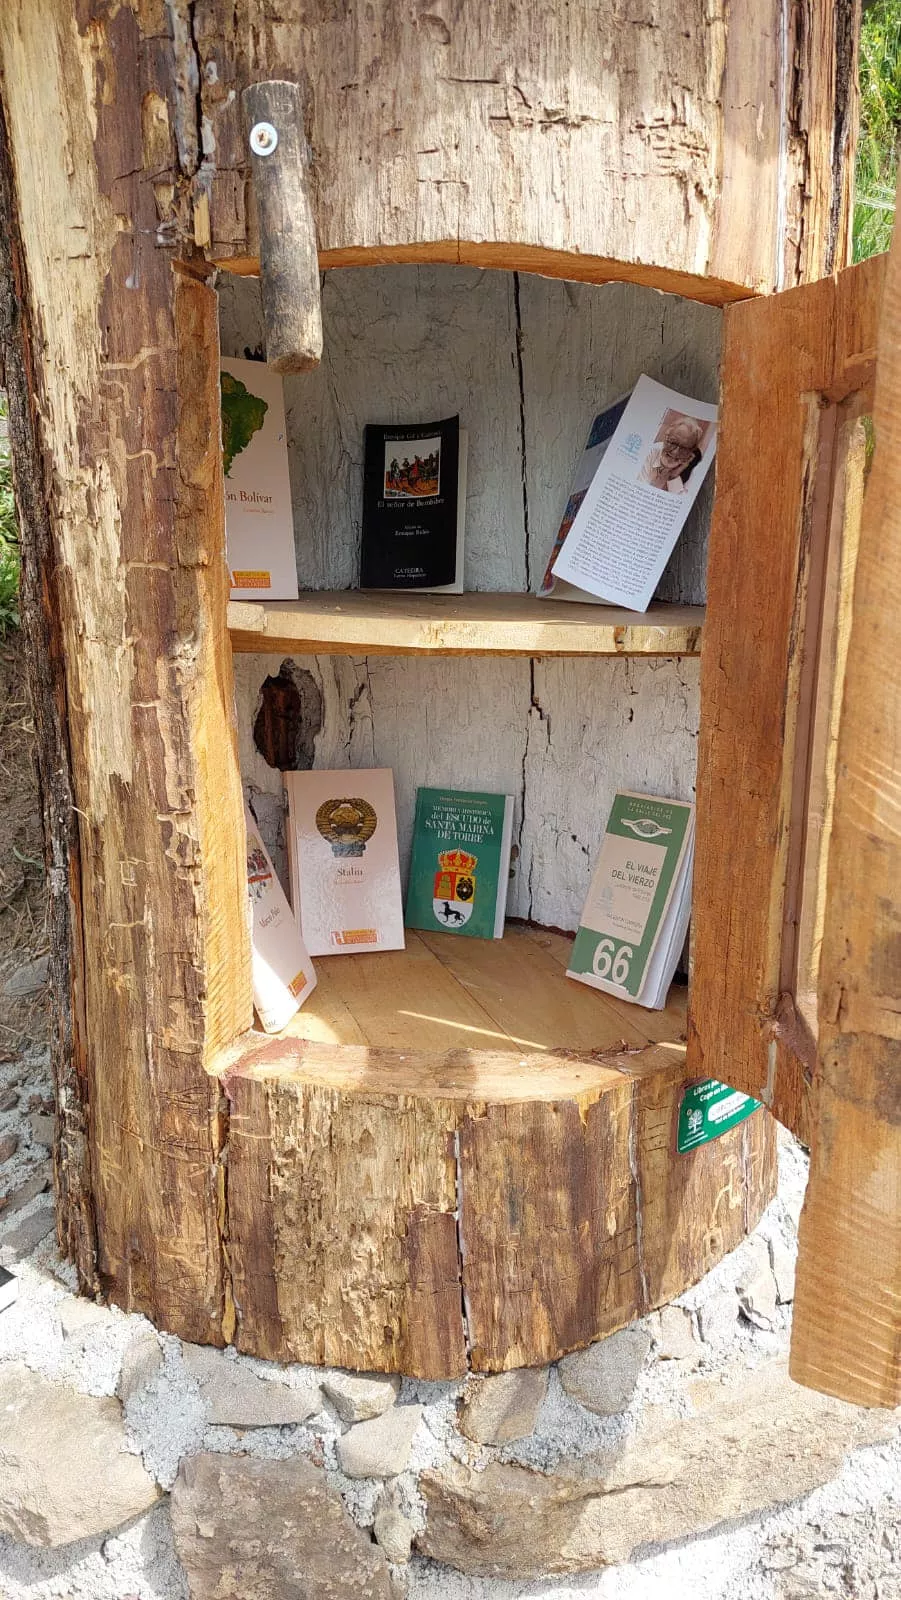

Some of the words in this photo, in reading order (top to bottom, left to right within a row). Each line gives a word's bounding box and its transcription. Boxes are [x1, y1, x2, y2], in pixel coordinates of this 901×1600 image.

[377, 500, 385, 508] El
[431, 811, 443, 821] del
[446, 812, 482, 823] ESCUDO
[483, 816, 492, 825] de
[425, 818, 456, 831] SANTA
[459, 822, 495, 835] MARINA
[437, 830, 451, 840] DE
[452, 831, 484, 844] TORRE
[337, 866, 364, 877] Stalin
[625, 860, 636, 871] EL
[637, 863, 658, 877] VIAJE
[611, 869, 626, 881] DEL
[628, 873, 655, 888] VIERZO
[592, 938, 633, 985] 66
